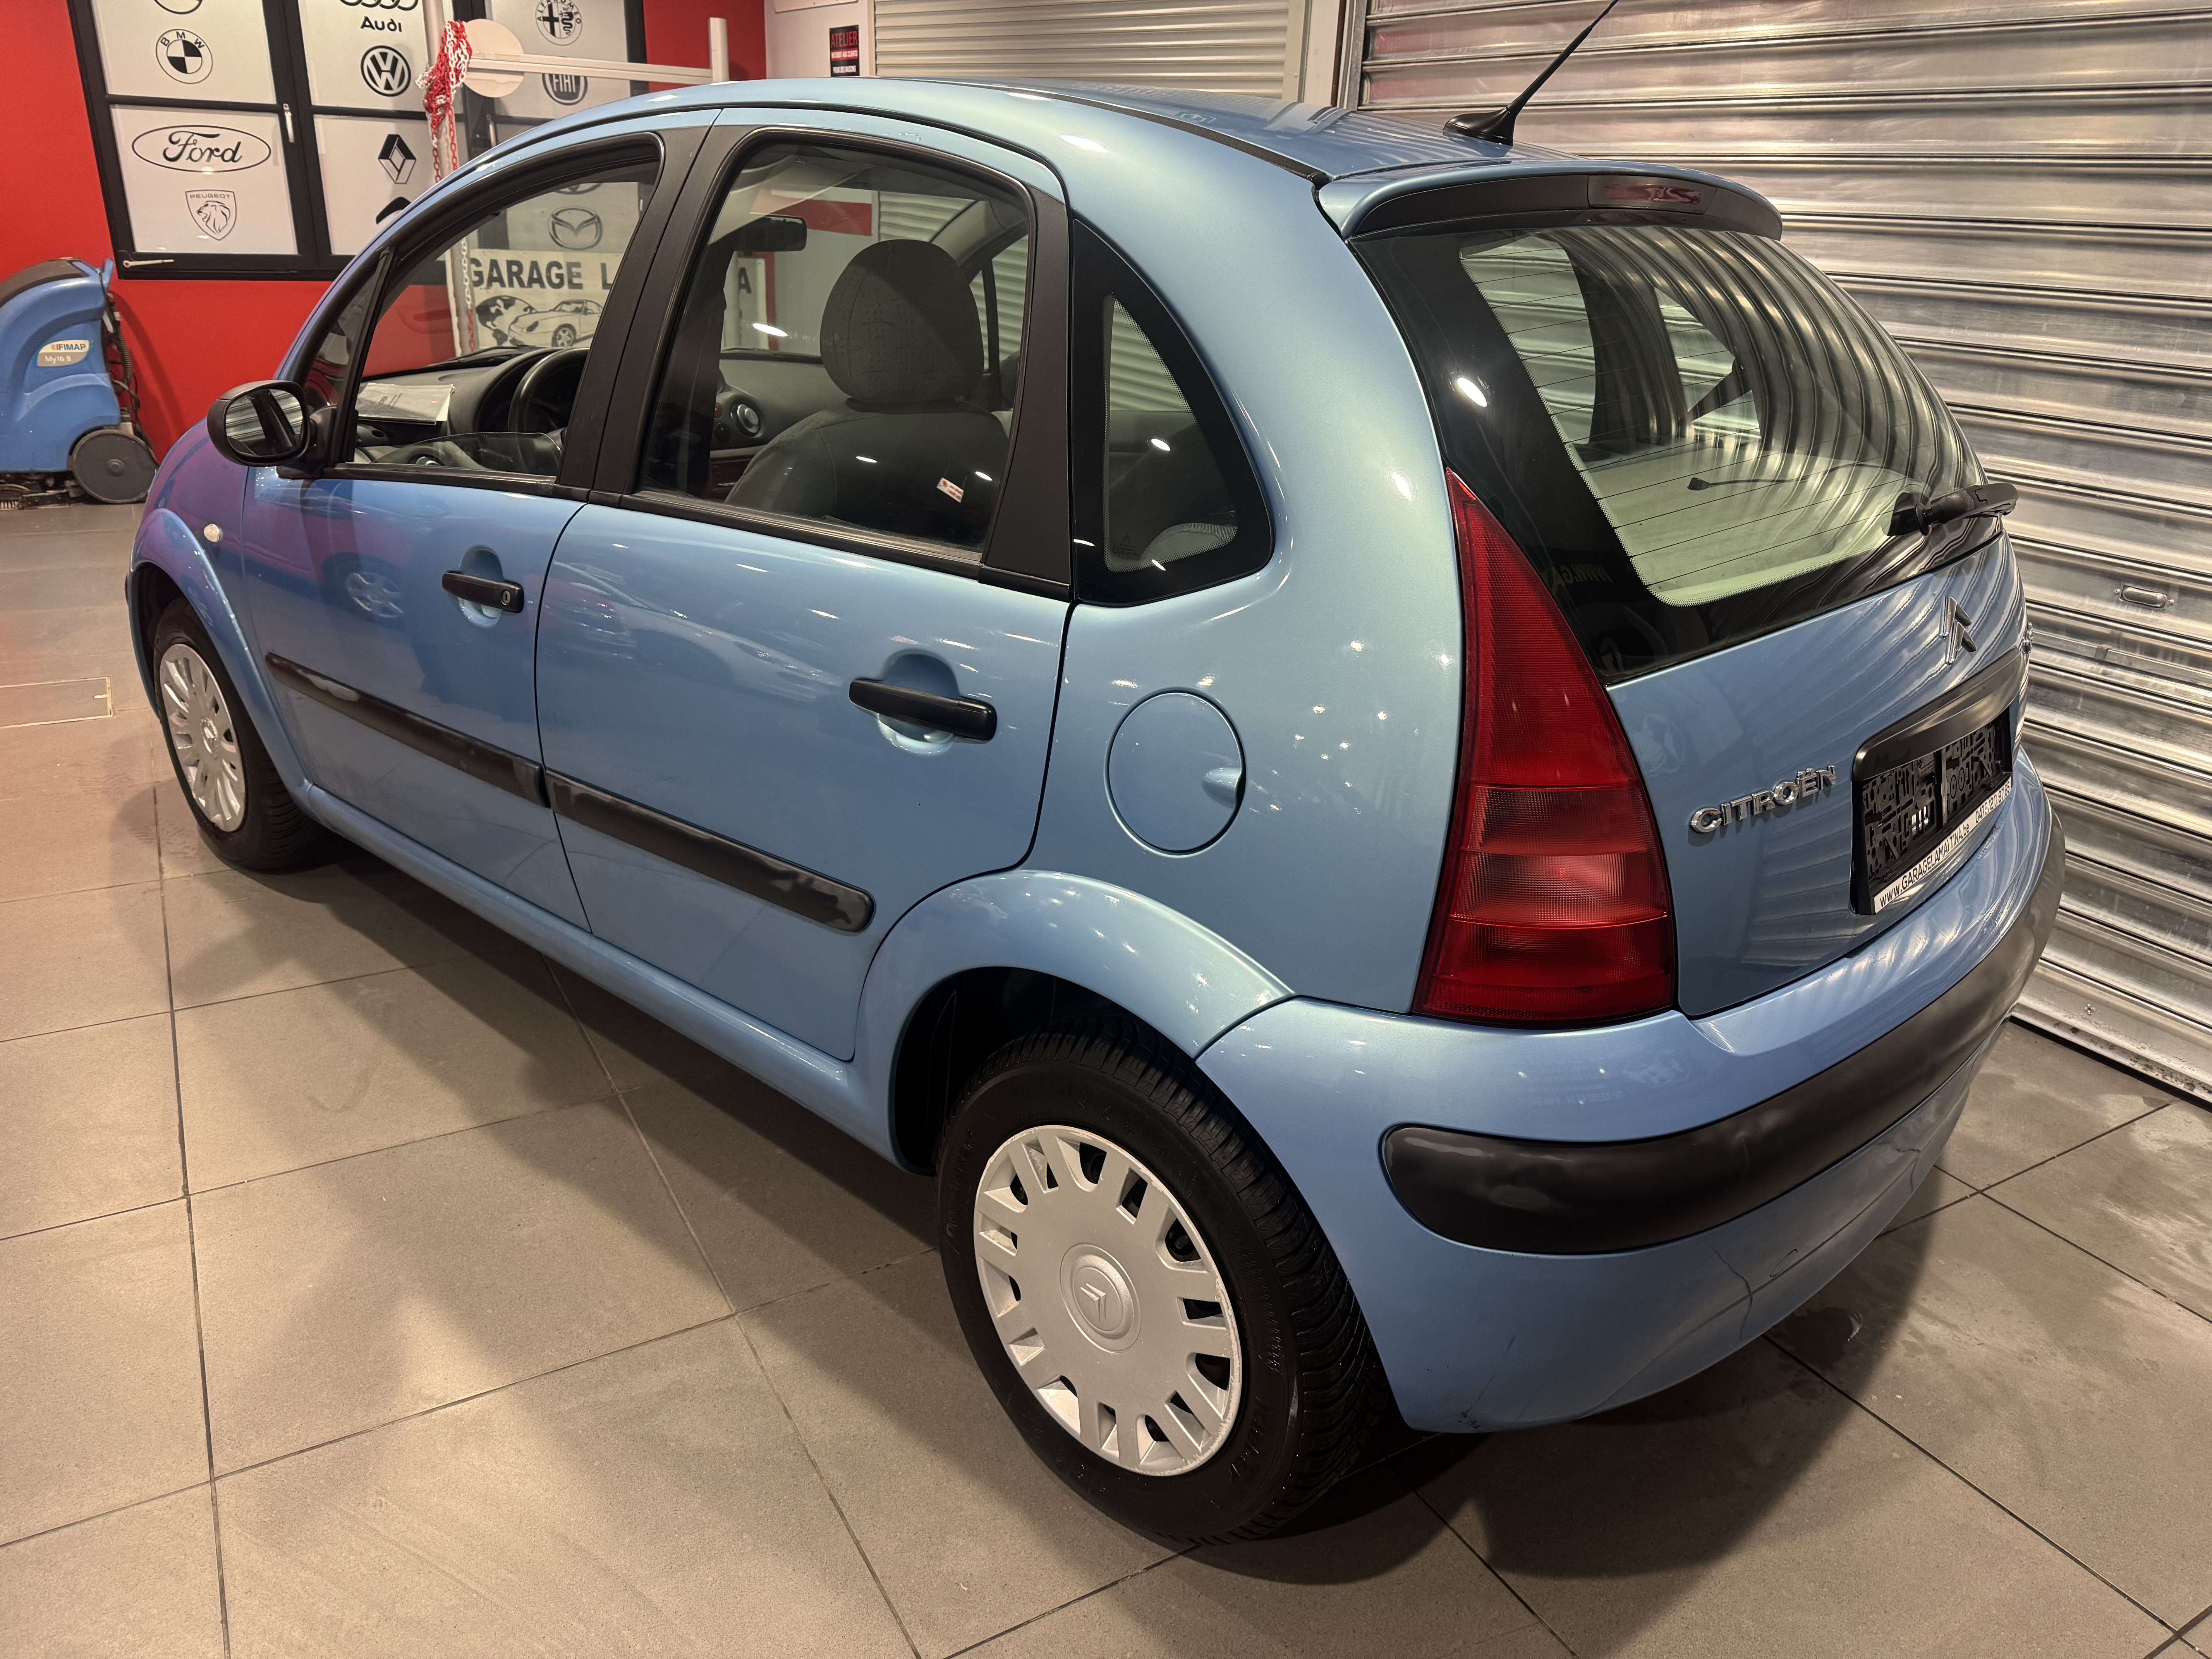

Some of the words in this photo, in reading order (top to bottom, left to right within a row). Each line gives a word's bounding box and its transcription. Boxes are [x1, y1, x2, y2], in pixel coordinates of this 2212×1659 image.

[360, 16, 402, 32] Audi
[160, 31, 204, 48] BMW
[831, 31, 857, 48] ATELIER
[163, 131, 242, 163] Ford
[469, 258, 583, 290] GARAGE
[1690, 765, 1837, 833] CITROËN
